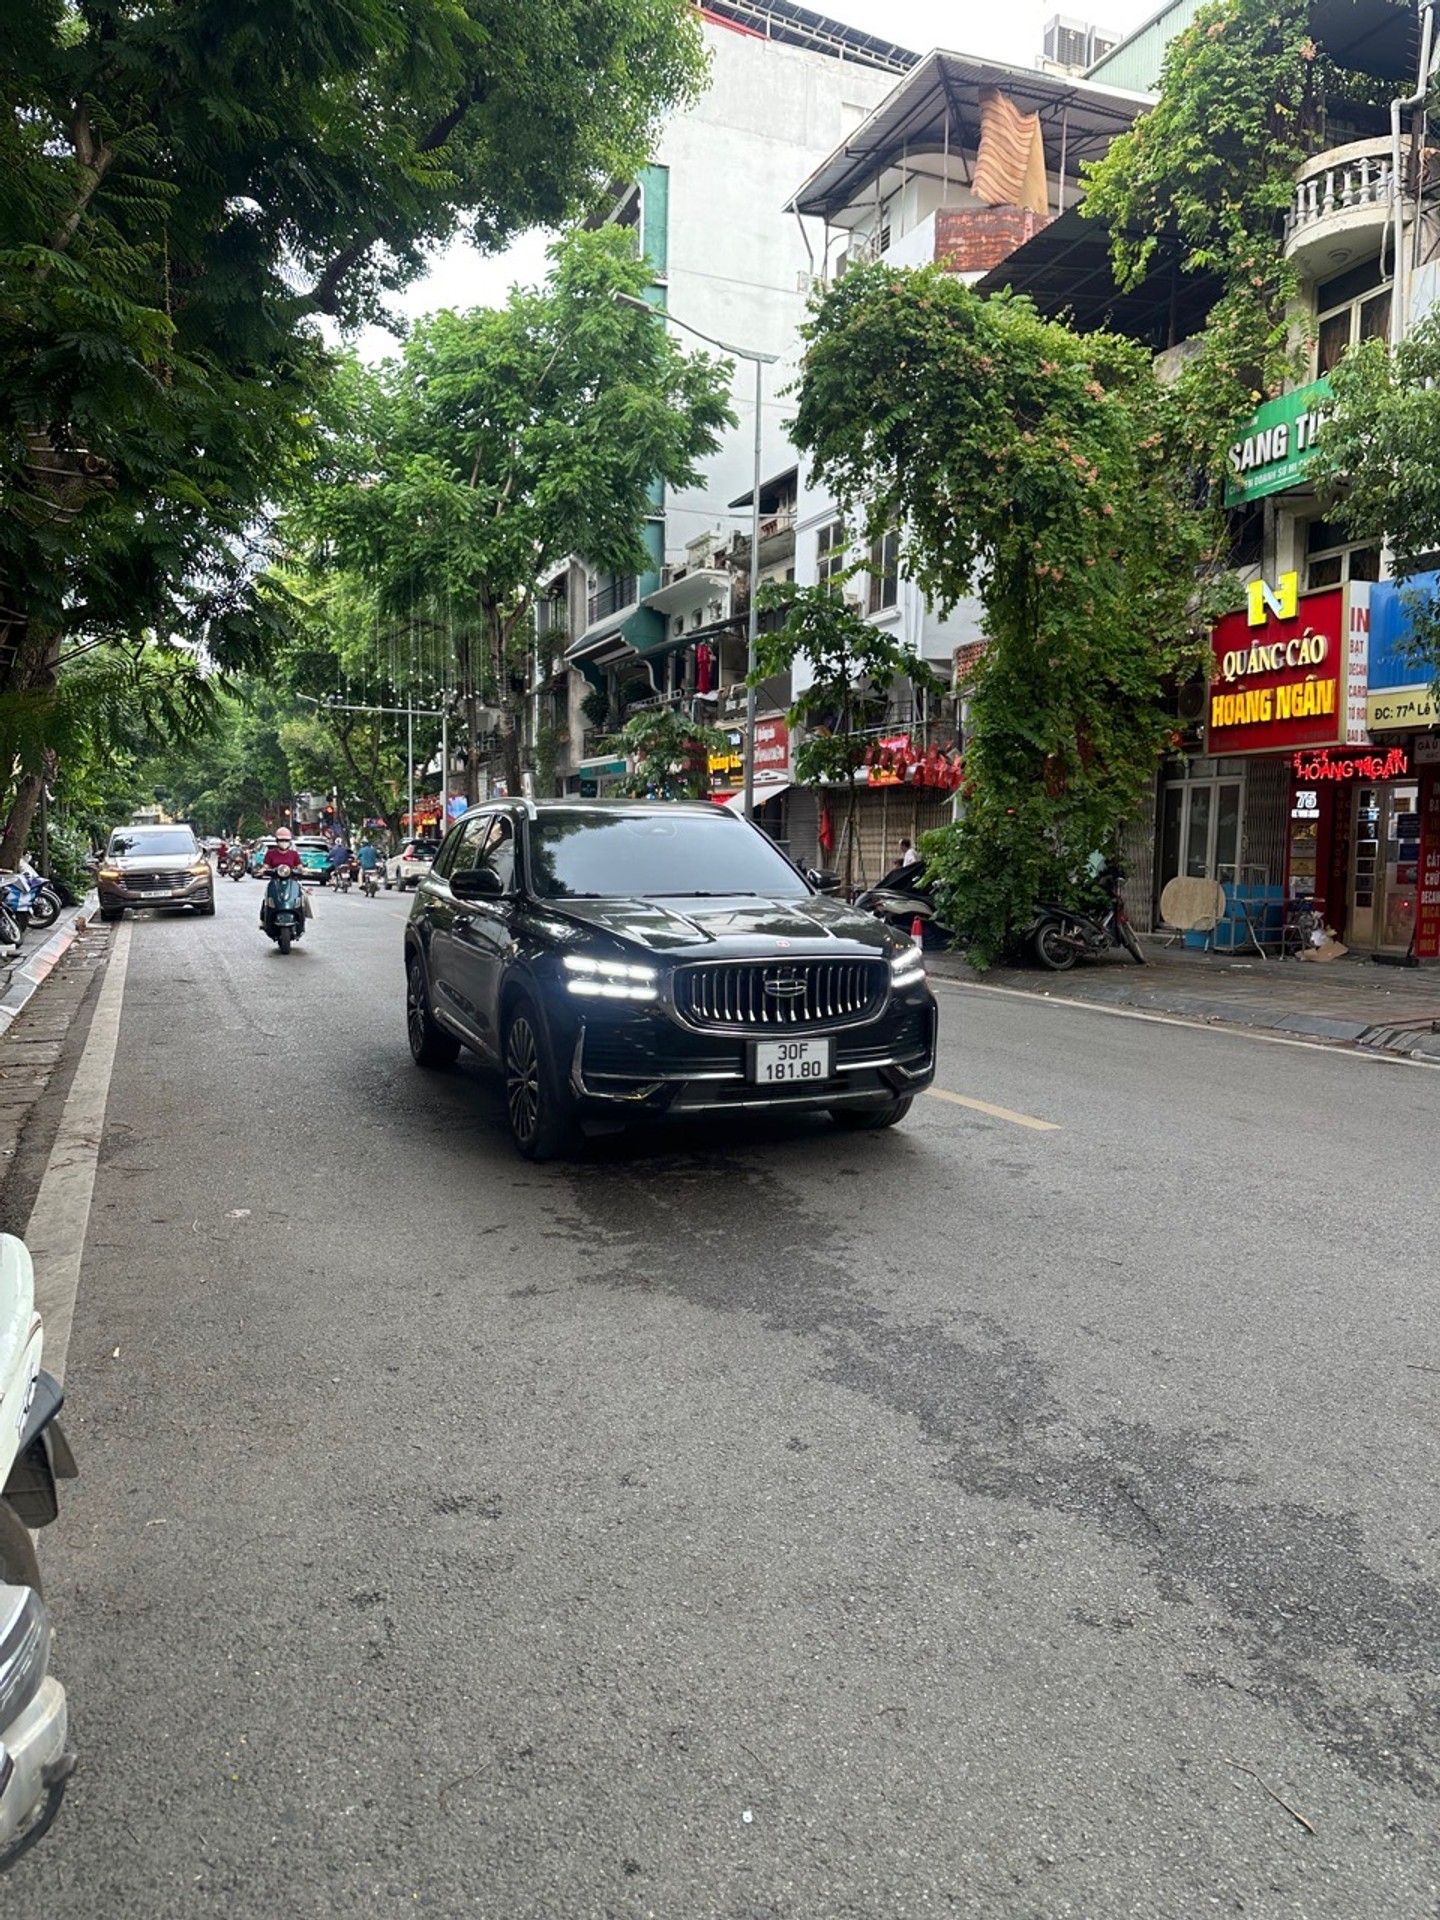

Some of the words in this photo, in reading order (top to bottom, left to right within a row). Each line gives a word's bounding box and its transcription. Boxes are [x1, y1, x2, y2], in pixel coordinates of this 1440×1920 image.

[1228, 423, 1288, 472] SANG
[1350, 607, 1369, 633] IN
[1223, 639, 1286, 682] QUẢNG
[1286, 627, 1328, 666] CÁO
[1212, 684, 1273, 727] HOÀNG
[1276, 674, 1336, 720] NGÂN
[1375, 706, 1393, 720] ĐC:
[1417, 702, 1430, 716] Lê
[1295, 790, 1317, 808] 75
[778, 1043, 809, 1060] 30F
[766, 1061, 821, 1080] 181.80
